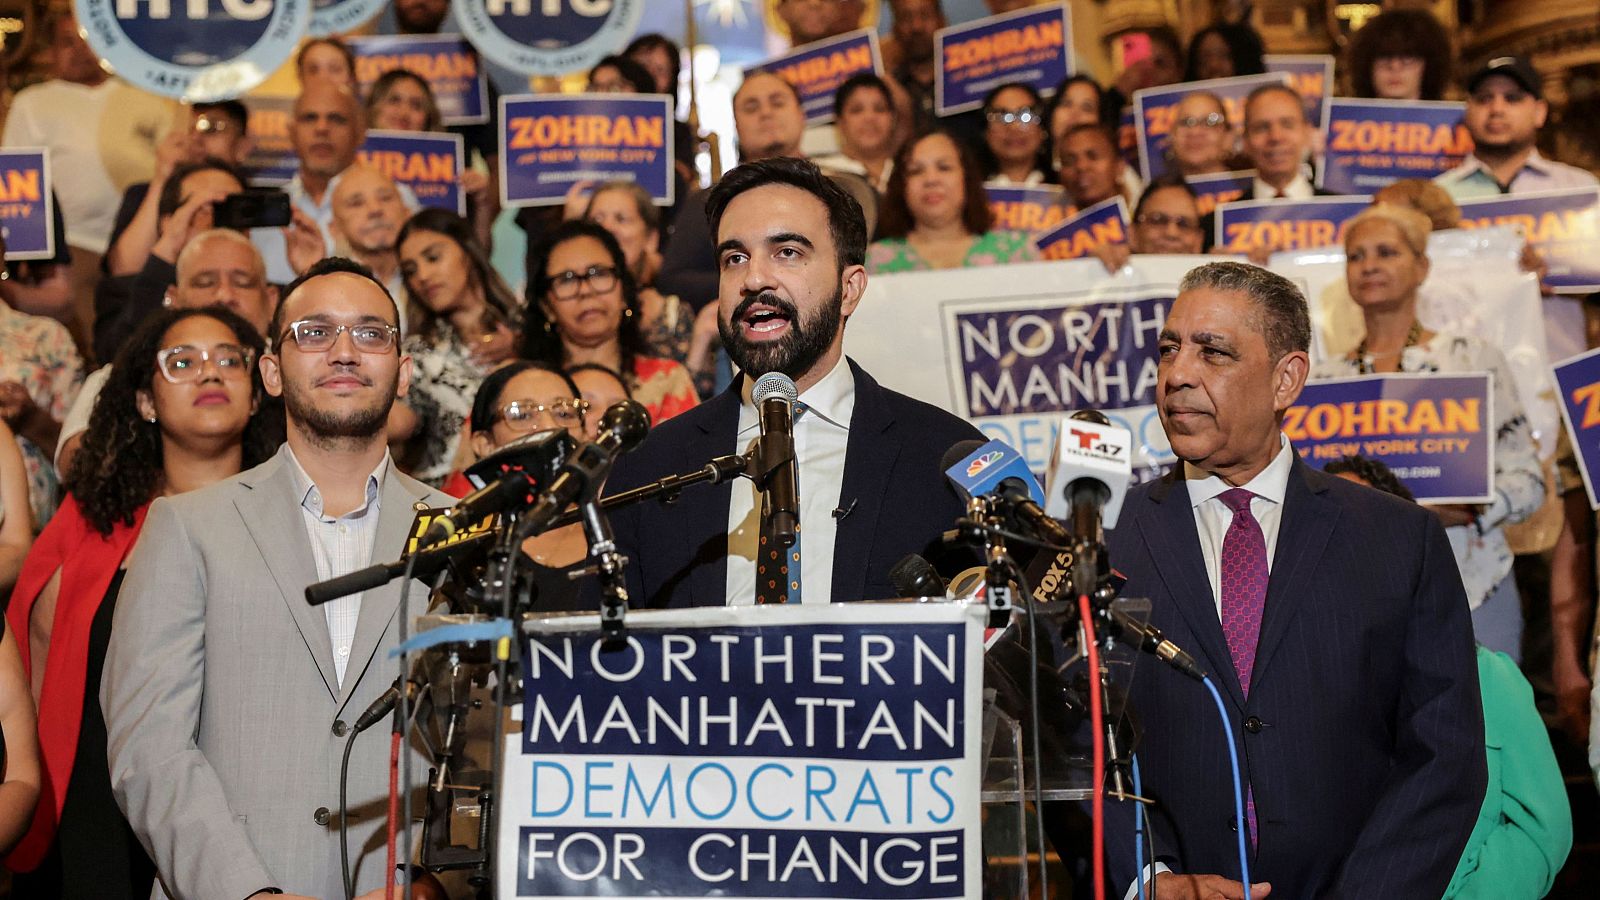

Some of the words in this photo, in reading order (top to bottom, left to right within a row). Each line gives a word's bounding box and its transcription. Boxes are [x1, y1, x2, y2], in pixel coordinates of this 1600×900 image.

[509, 114, 664, 149] ZOHRAN
[962, 302, 1165, 363] NORTH
[969, 356, 1158, 413] MANHA
[1281, 398, 1481, 441] ZOHRAN
[1095, 442, 1123, 457] 47
[1312, 442, 1361, 459] NEW
[1363, 438, 1419, 457] YORK
[1420, 436, 1470, 455] CITY
[529, 633, 956, 686] NORTHERN
[529, 693, 955, 750] MANHATTAN
[531, 761, 955, 825] DEMOCRATS
[527, 831, 646, 882] FOR
[687, 832, 959, 886] CHANGE
